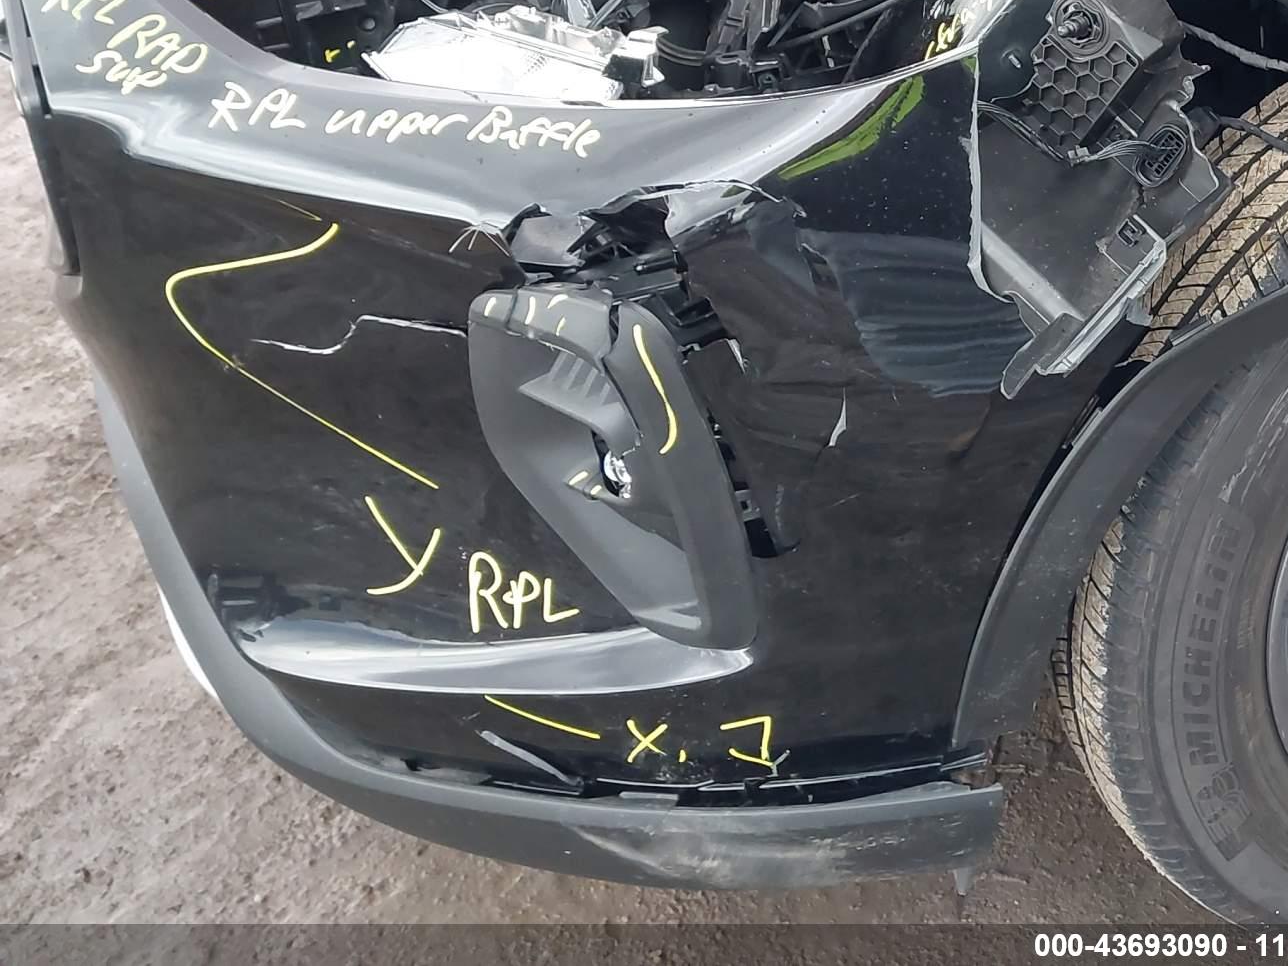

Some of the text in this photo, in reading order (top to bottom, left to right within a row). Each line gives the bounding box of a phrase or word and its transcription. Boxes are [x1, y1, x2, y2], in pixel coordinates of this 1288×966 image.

[106, 14, 209, 74] RAD
[207, 81, 306, 132] RPL
[468, 551, 580, 633] RPL
